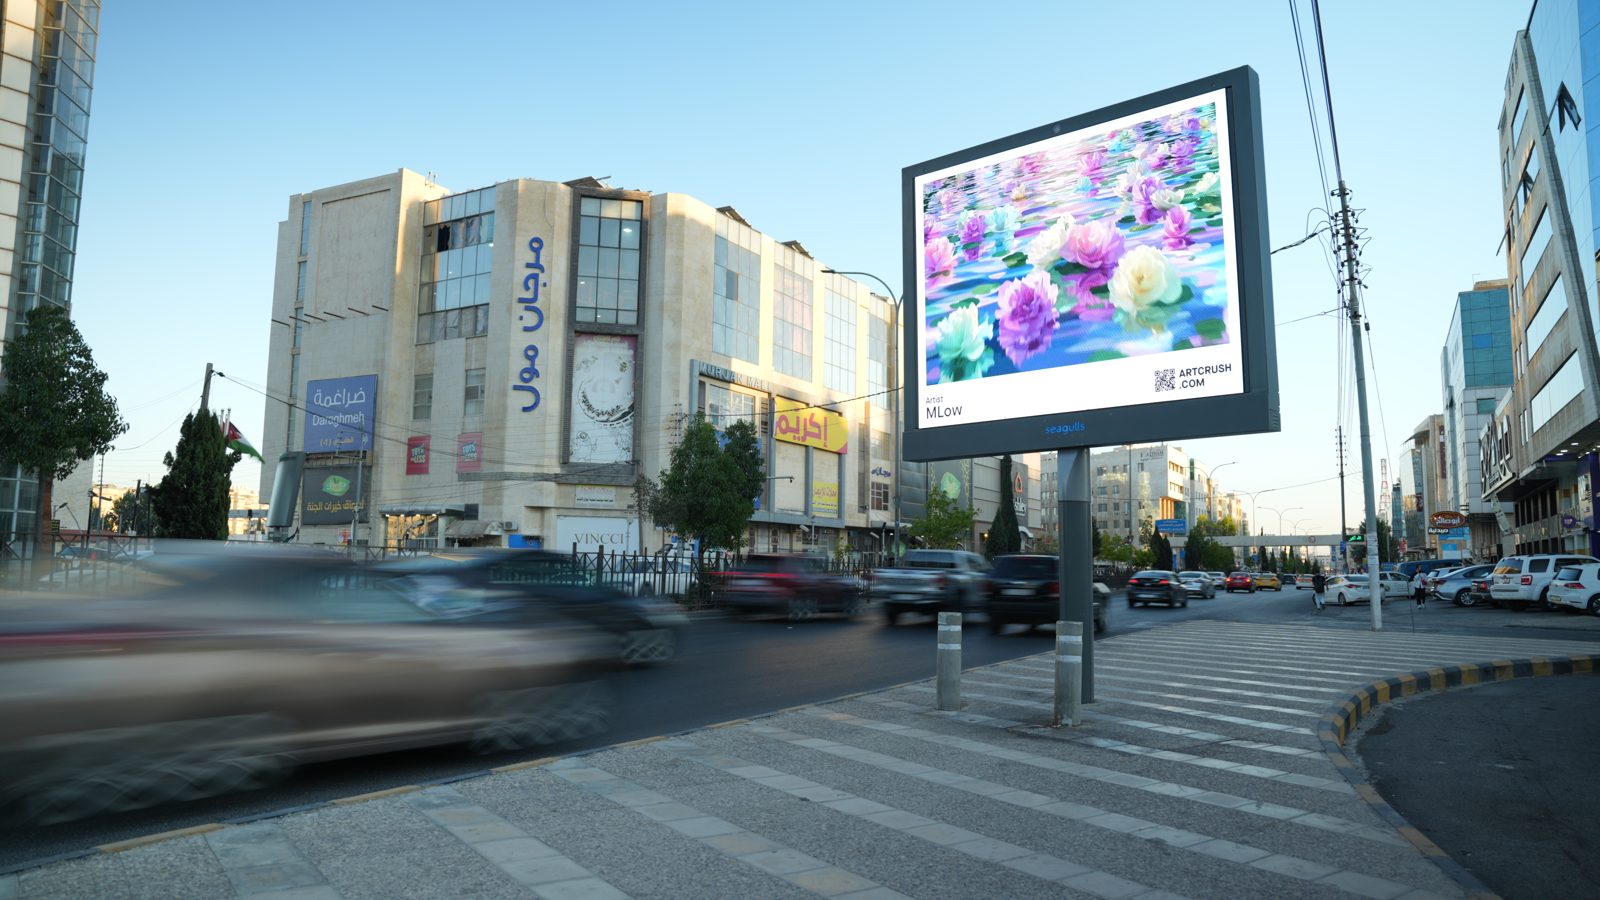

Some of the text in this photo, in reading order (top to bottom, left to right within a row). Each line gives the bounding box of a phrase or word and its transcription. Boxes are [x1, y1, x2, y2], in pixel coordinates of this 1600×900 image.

[512, 236, 547, 412] مرجان مول
[1179, 364, 1232, 378] ARTCRUSH
[1179, 378, 1205, 389] .COM
[314, 387, 366, 408] ضراغمة
[925, 395, 944, 405] Artist
[312, 411, 365, 428] Daraghmeh
[1044, 421, 1086, 435] seagulls
[574, 533, 624, 545] VINCCI
